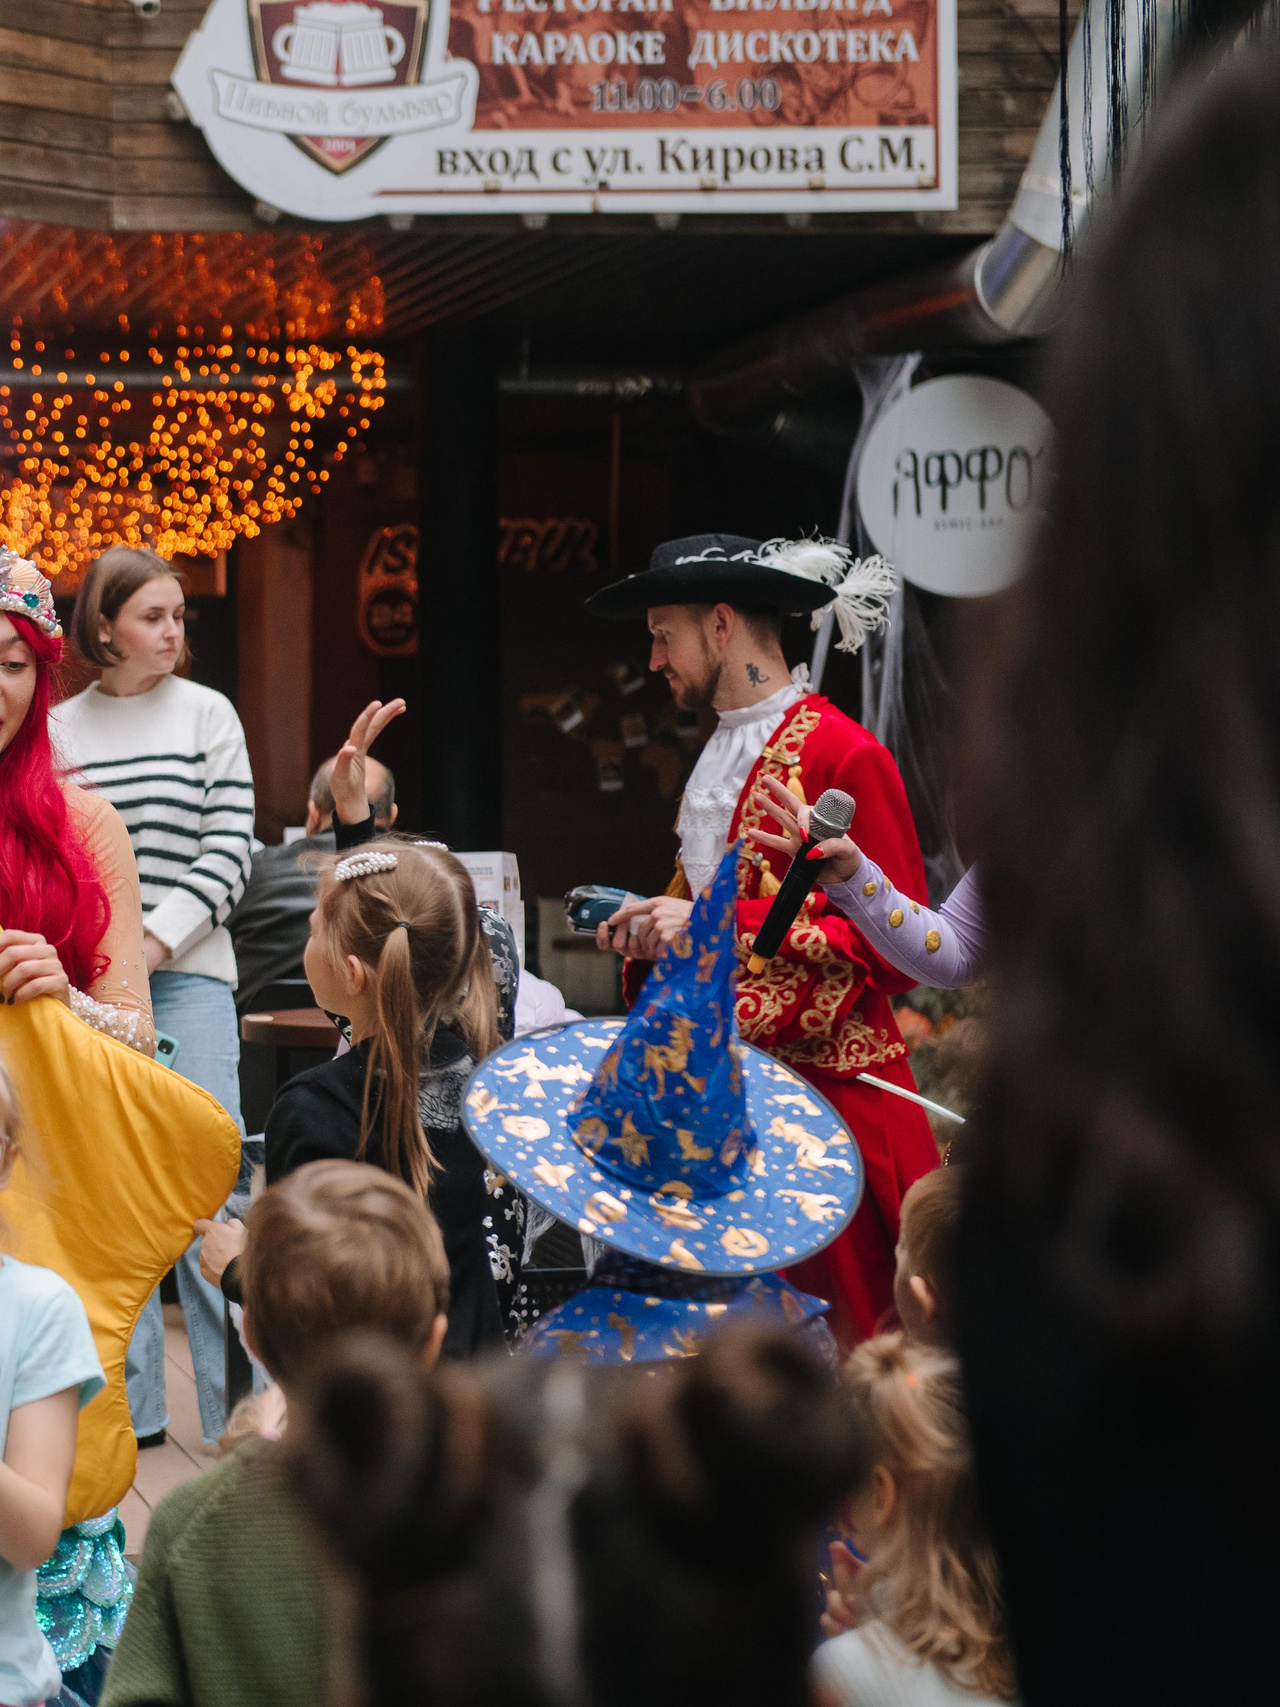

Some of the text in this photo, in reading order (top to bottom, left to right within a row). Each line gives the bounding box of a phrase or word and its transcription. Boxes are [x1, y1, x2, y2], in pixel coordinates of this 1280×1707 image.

[491, 29, 920, 71] КАРАОКЕ ДИСКОТЕКА
[224, 80, 455, 133] Пивной бульвар
[436, 135, 926, 185] вход с ул. Кирова С.М.
[892, 445, 1045, 518] АФФО
